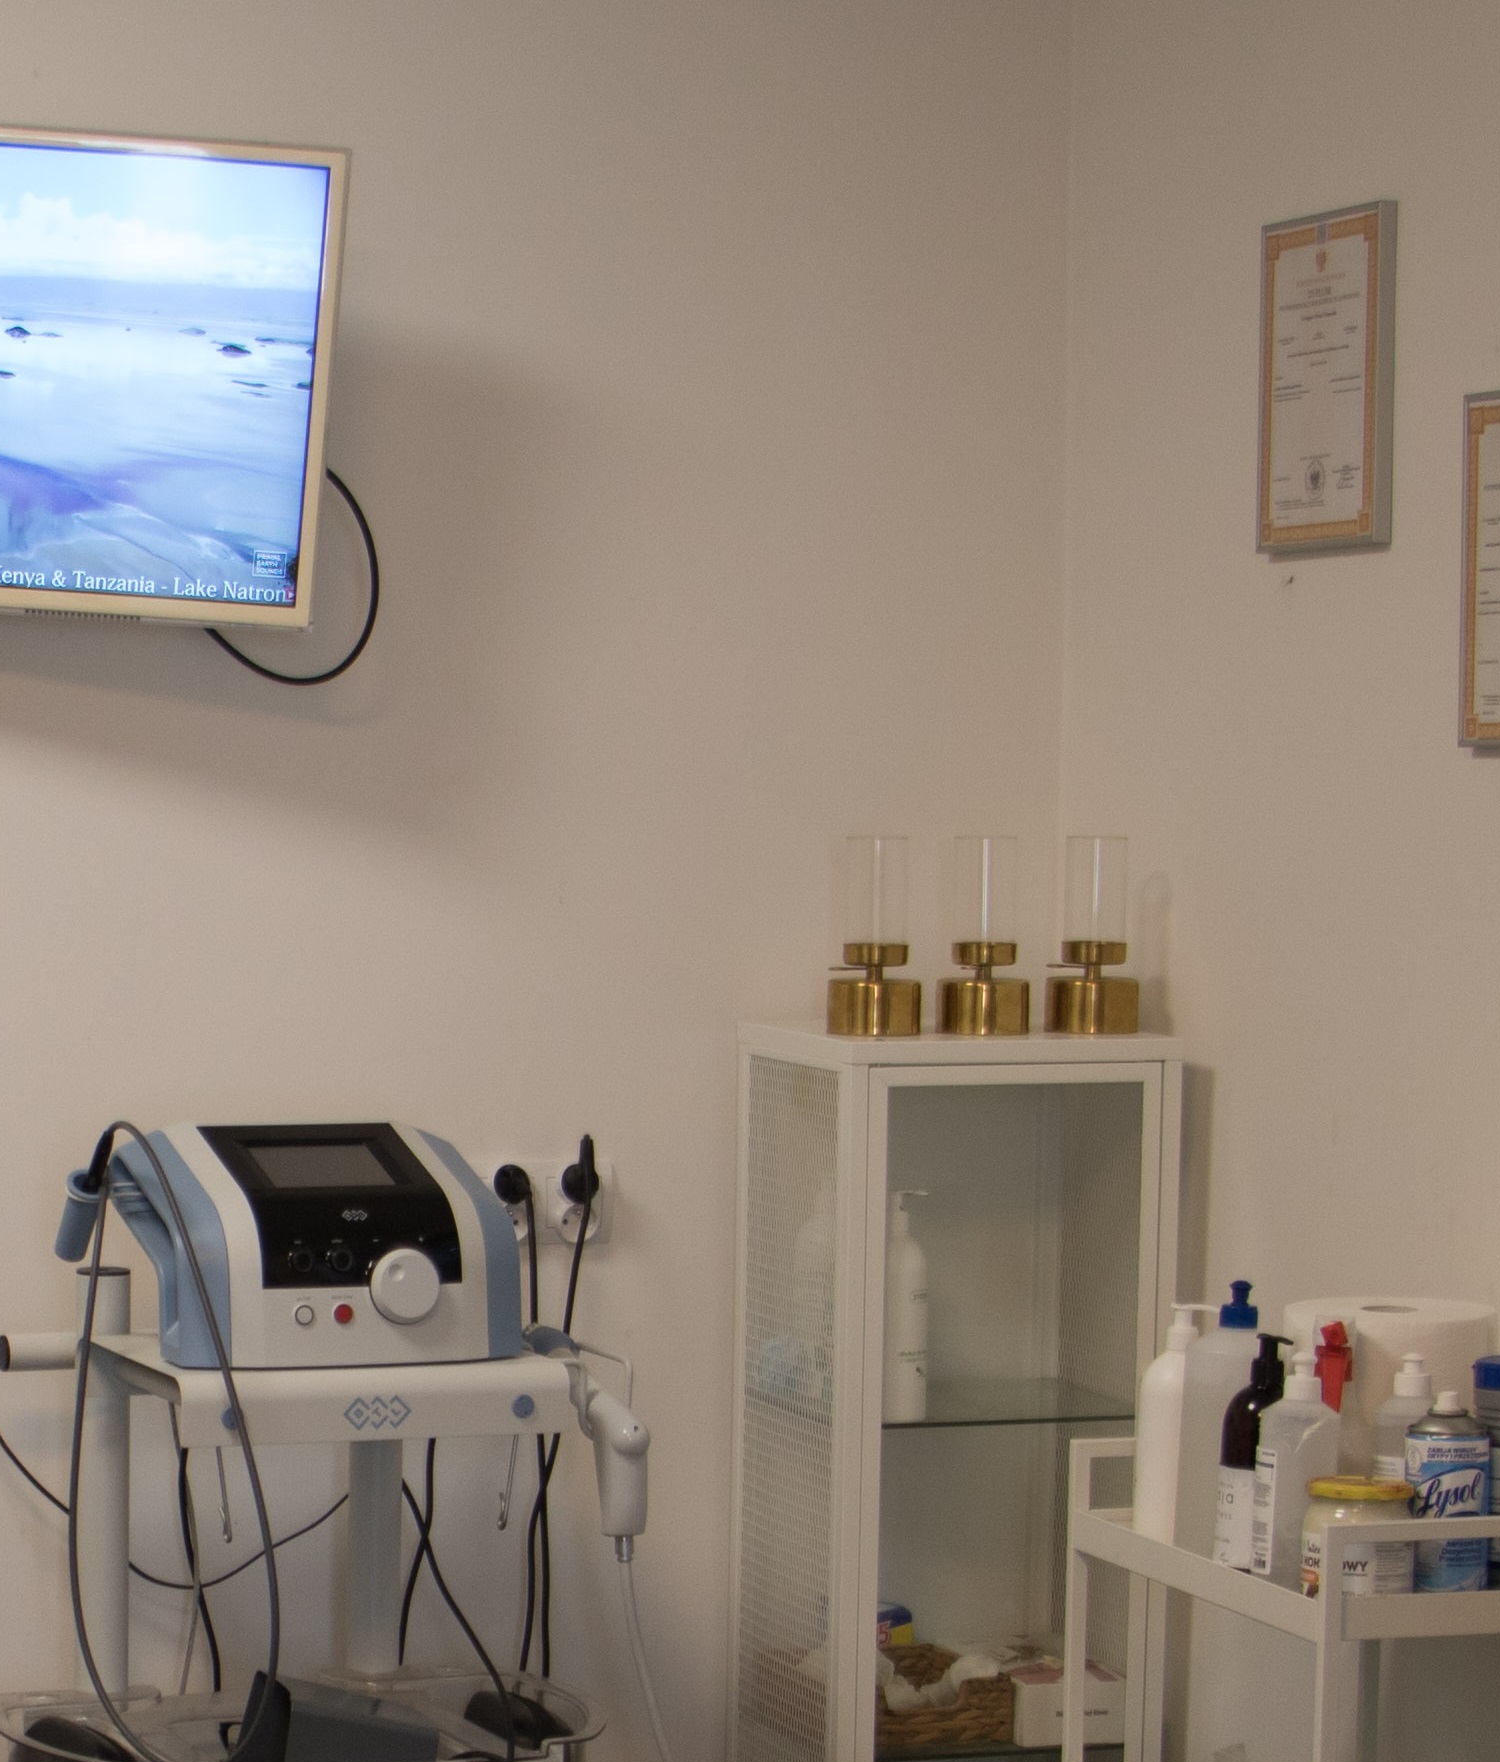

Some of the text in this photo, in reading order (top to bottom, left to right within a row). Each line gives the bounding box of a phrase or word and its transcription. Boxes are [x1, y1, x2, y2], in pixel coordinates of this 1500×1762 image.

[53, 570, 68, 588] &
[73, 571, 155, 594] Tanzania
[173, 579, 217, 598] Lake
[222, 580, 287, 602] Natron
[1415, 1472, 1482, 1518] Lysol
